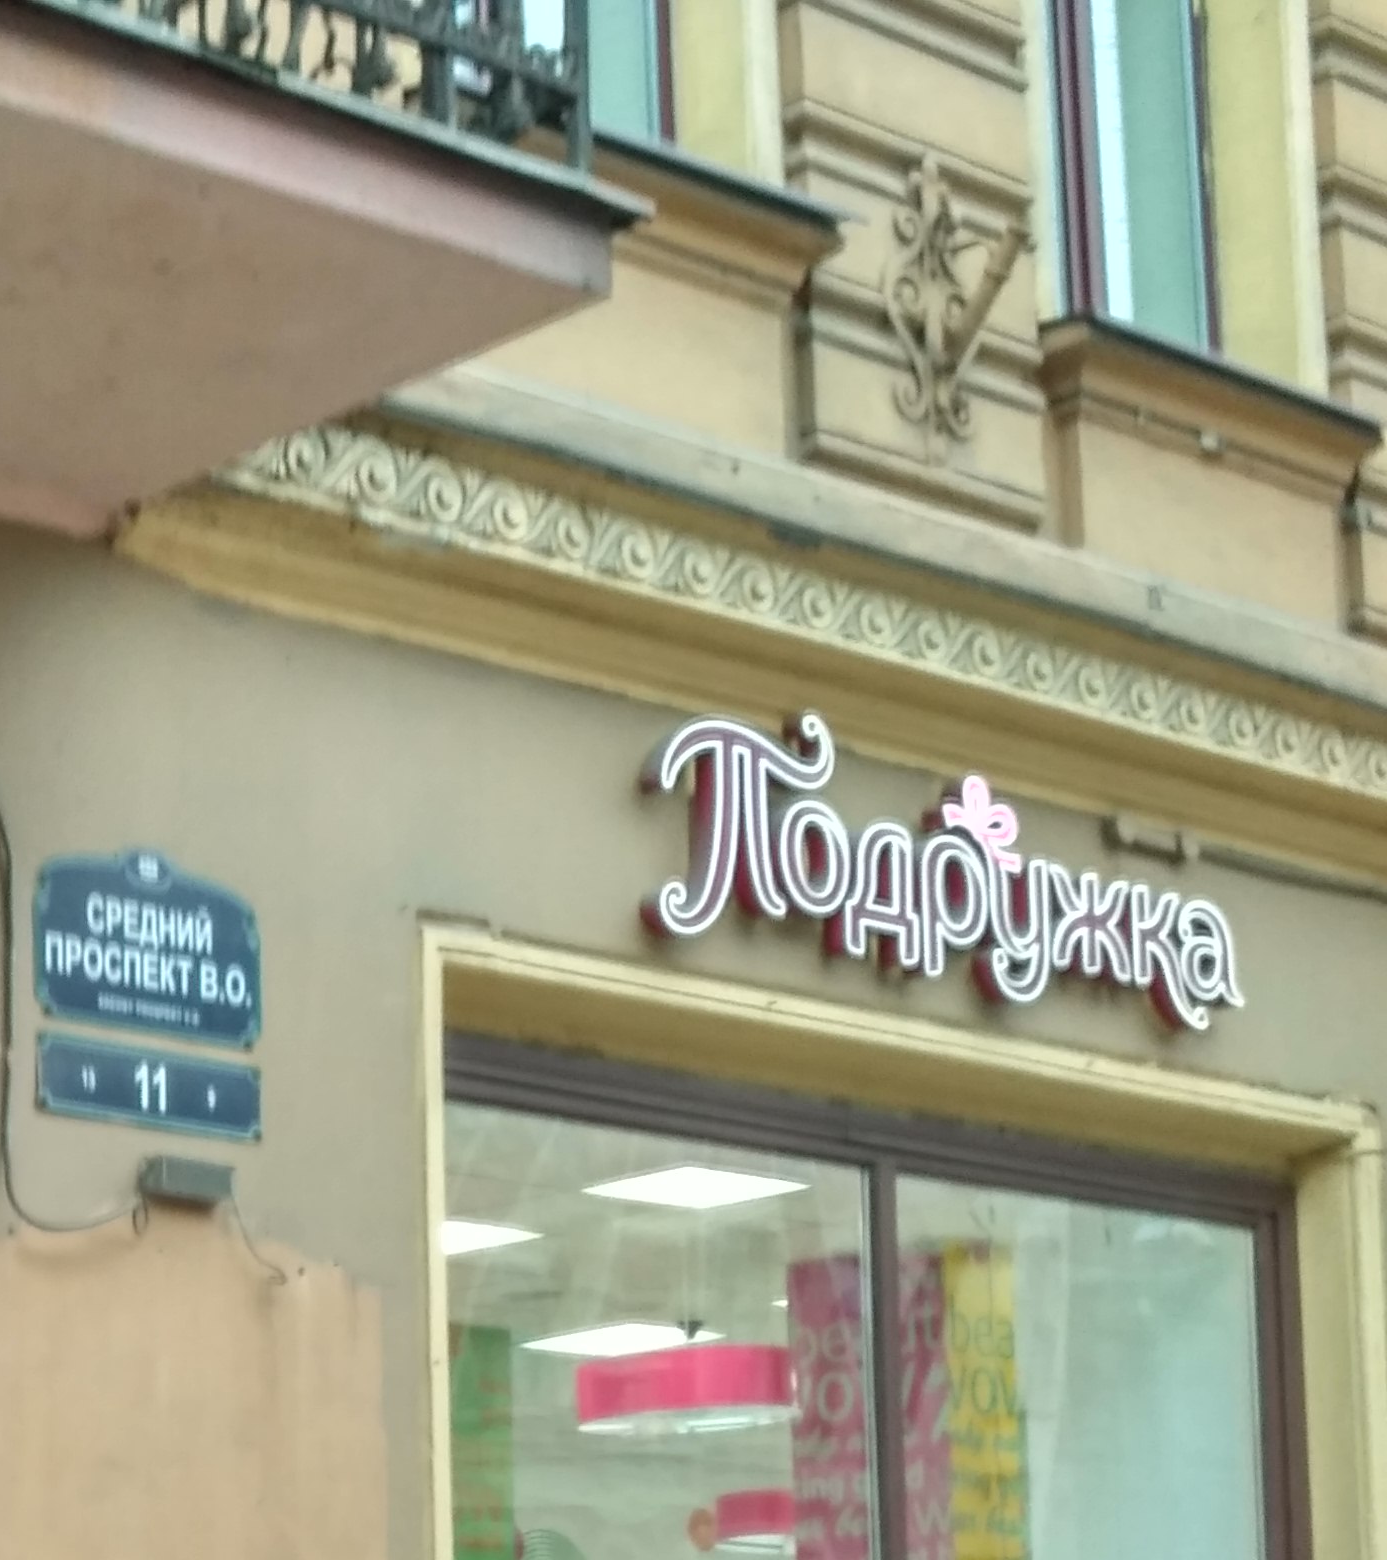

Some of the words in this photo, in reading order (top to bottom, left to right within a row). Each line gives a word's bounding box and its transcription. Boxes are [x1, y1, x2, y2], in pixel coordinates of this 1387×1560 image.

[659, 709, 1245, 1031] Подружка
[85, 891, 214, 955] СРЕДНИЙ
[44, 930, 194, 997] ПРОСПЕКТ
[198, 963, 253, 1011] В.О.
[133, 1059, 168, 1116] 11
